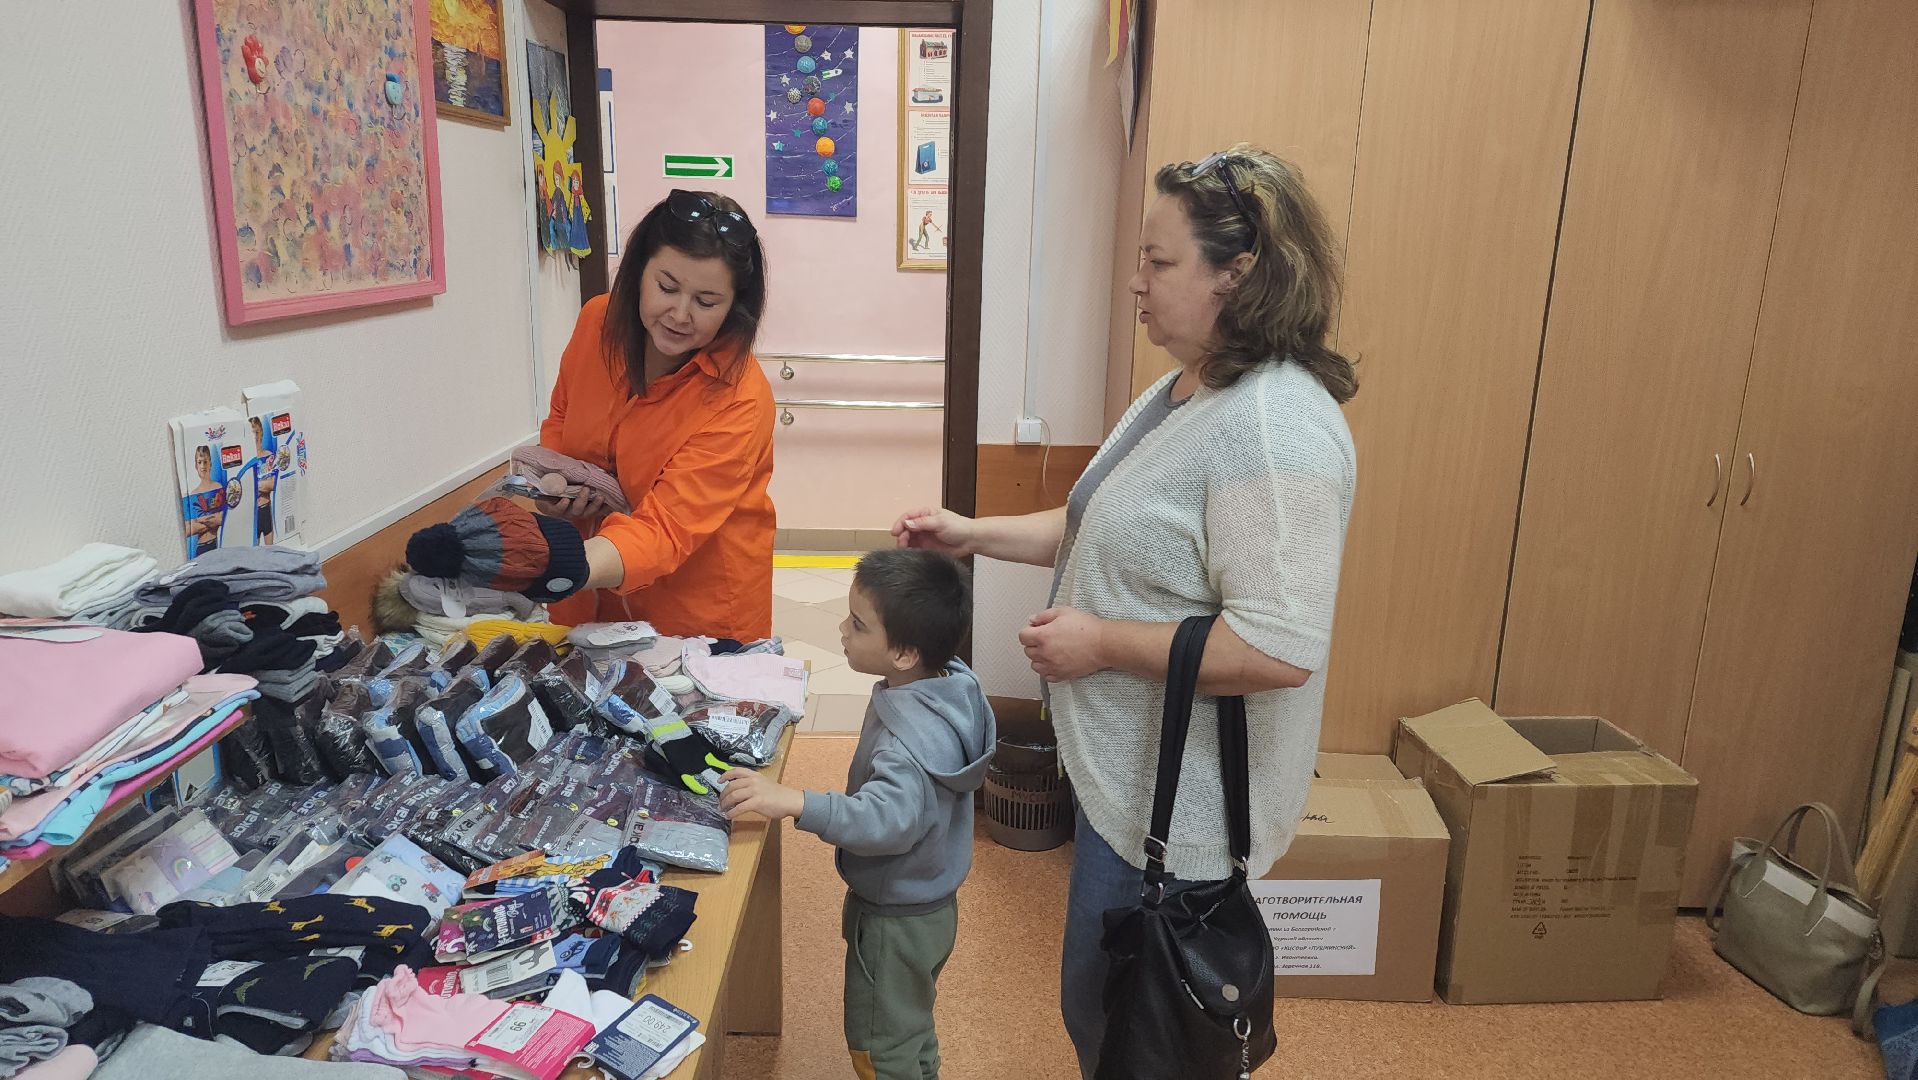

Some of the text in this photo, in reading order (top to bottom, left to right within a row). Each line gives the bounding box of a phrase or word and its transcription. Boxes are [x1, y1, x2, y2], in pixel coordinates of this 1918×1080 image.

[1254, 896, 1363, 904] АГОТВОРИТЕЛЬНАЯ
[1272, 911, 1327, 921] ПОМОЩЬ
[440, 971, 458, 999] UTURINO
